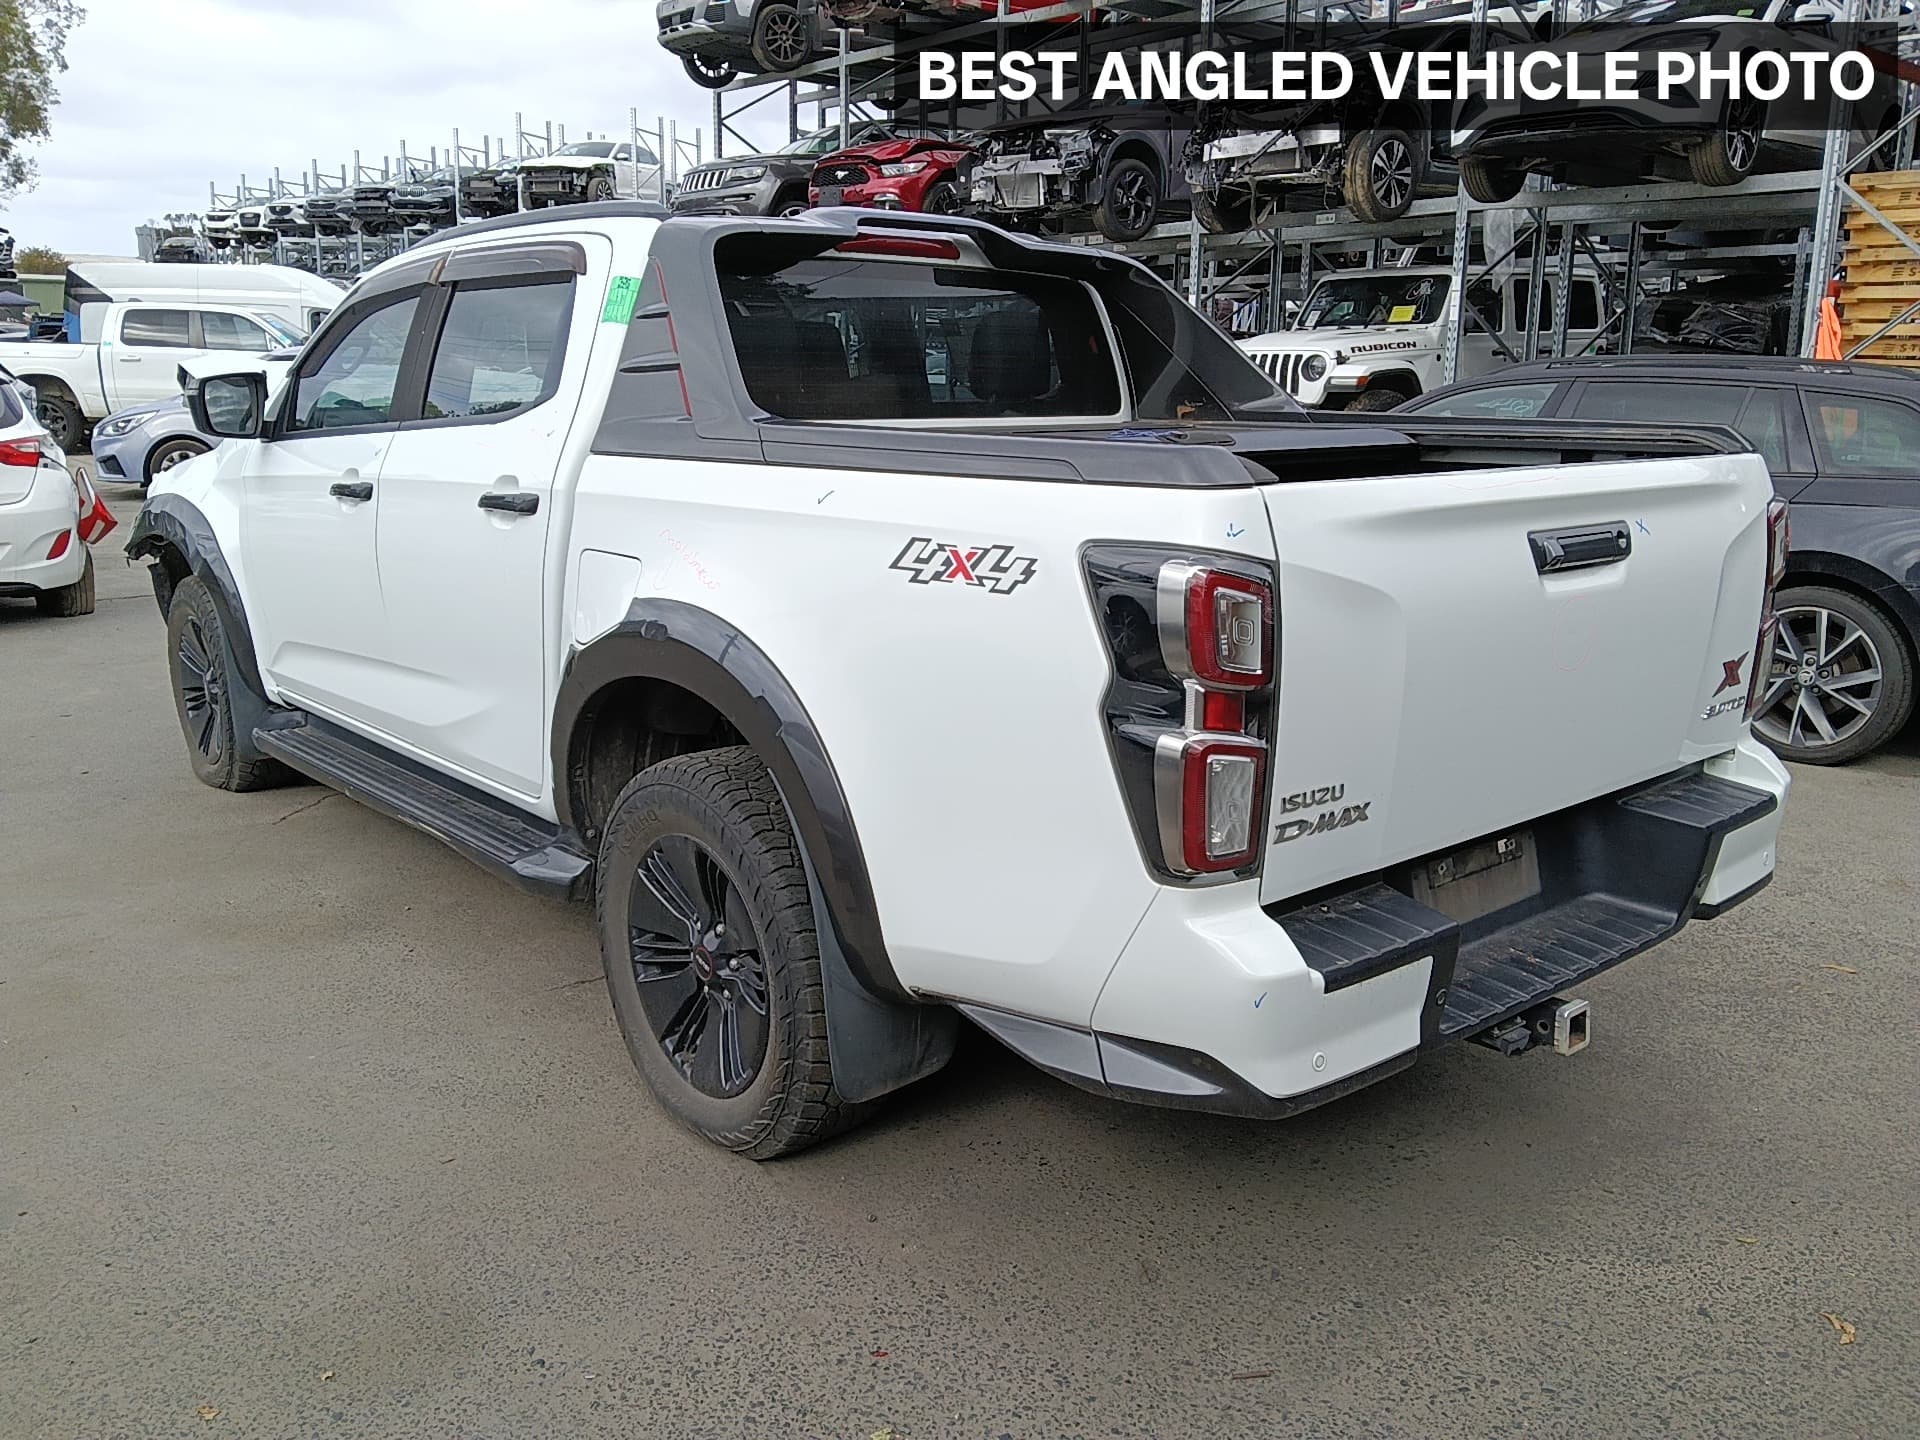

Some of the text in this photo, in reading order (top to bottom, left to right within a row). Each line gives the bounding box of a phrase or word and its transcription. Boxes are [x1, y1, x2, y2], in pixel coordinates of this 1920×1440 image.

[1350, 341, 1417, 353] RUBICON
[1280, 783, 1345, 815] ISUZU
[1272, 801, 1371, 845] D-MAX
